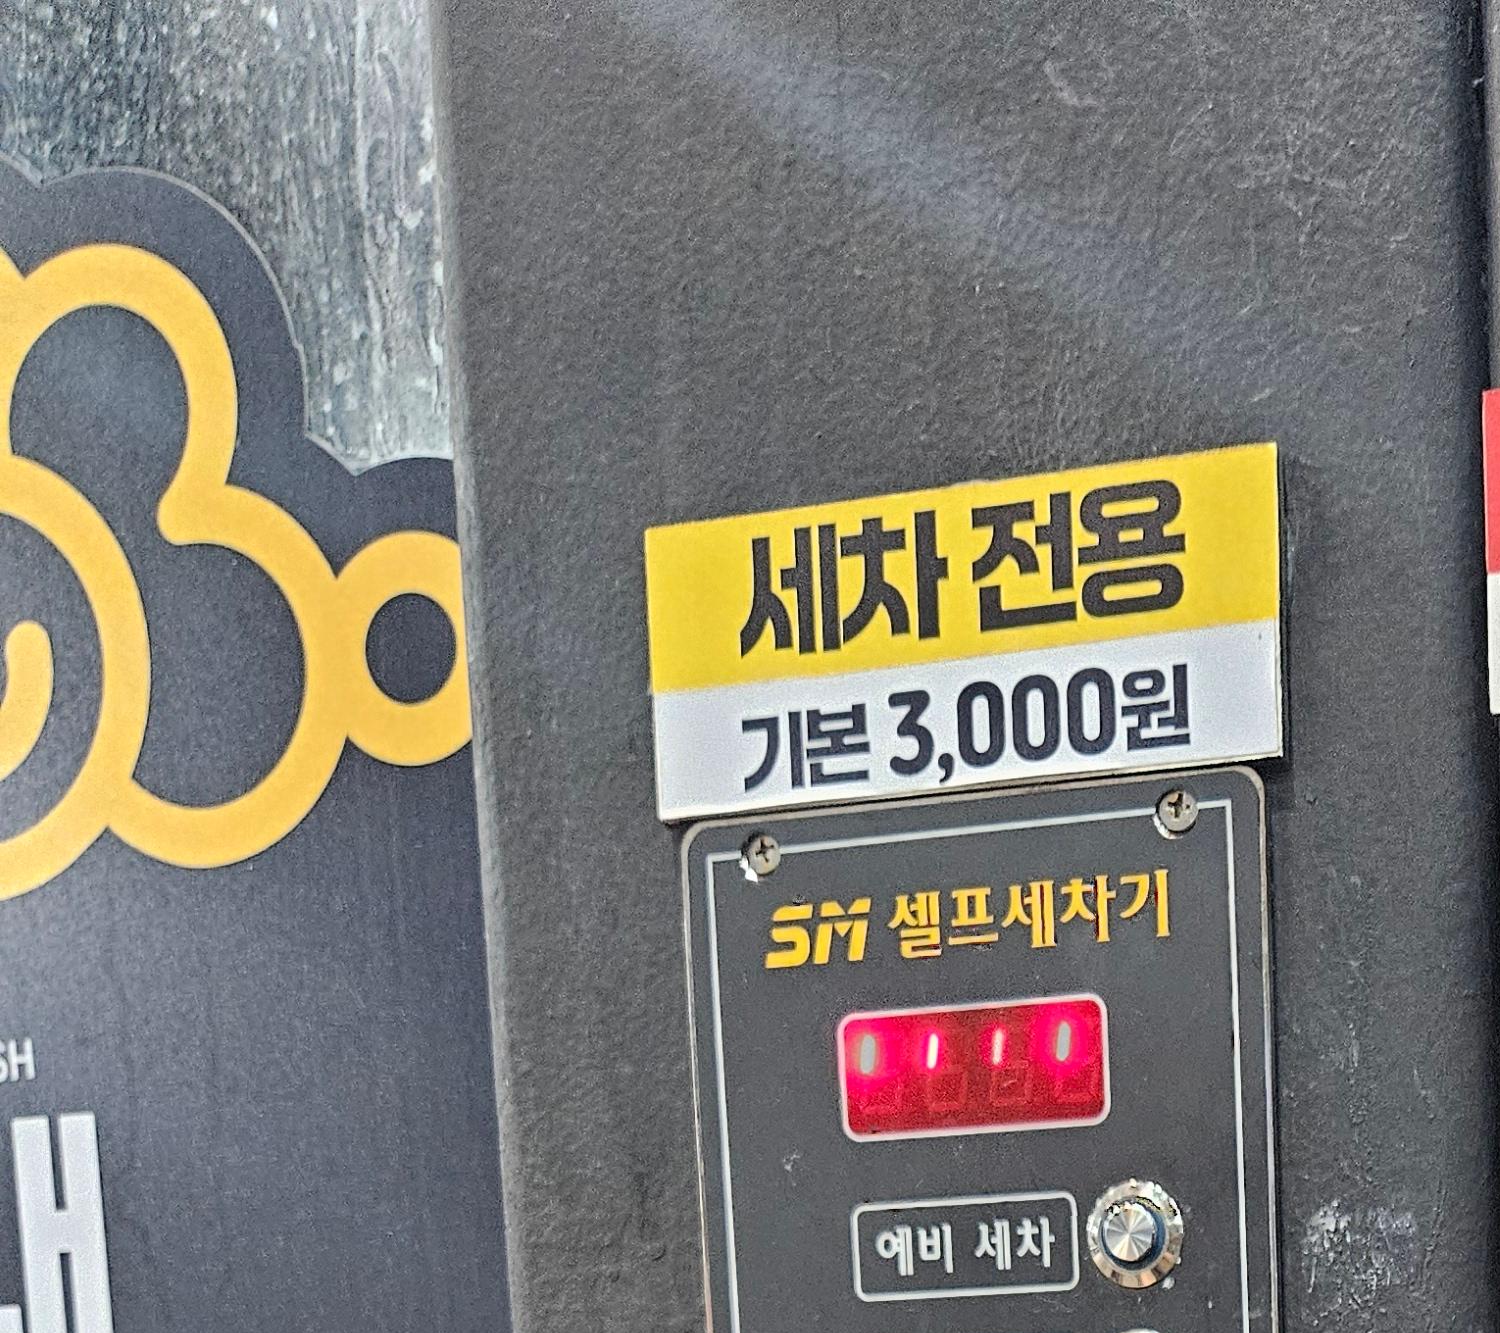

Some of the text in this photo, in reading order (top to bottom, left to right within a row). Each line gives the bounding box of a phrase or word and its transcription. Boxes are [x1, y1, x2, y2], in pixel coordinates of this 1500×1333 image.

[739, 479, 1185, 658] 세차 전용
[741, 663, 1191, 793] 기본 3,000원
[765, 869, 1170, 969] SM 셀프세차기
[876, 1217, 1056, 1276] 예비 세차
